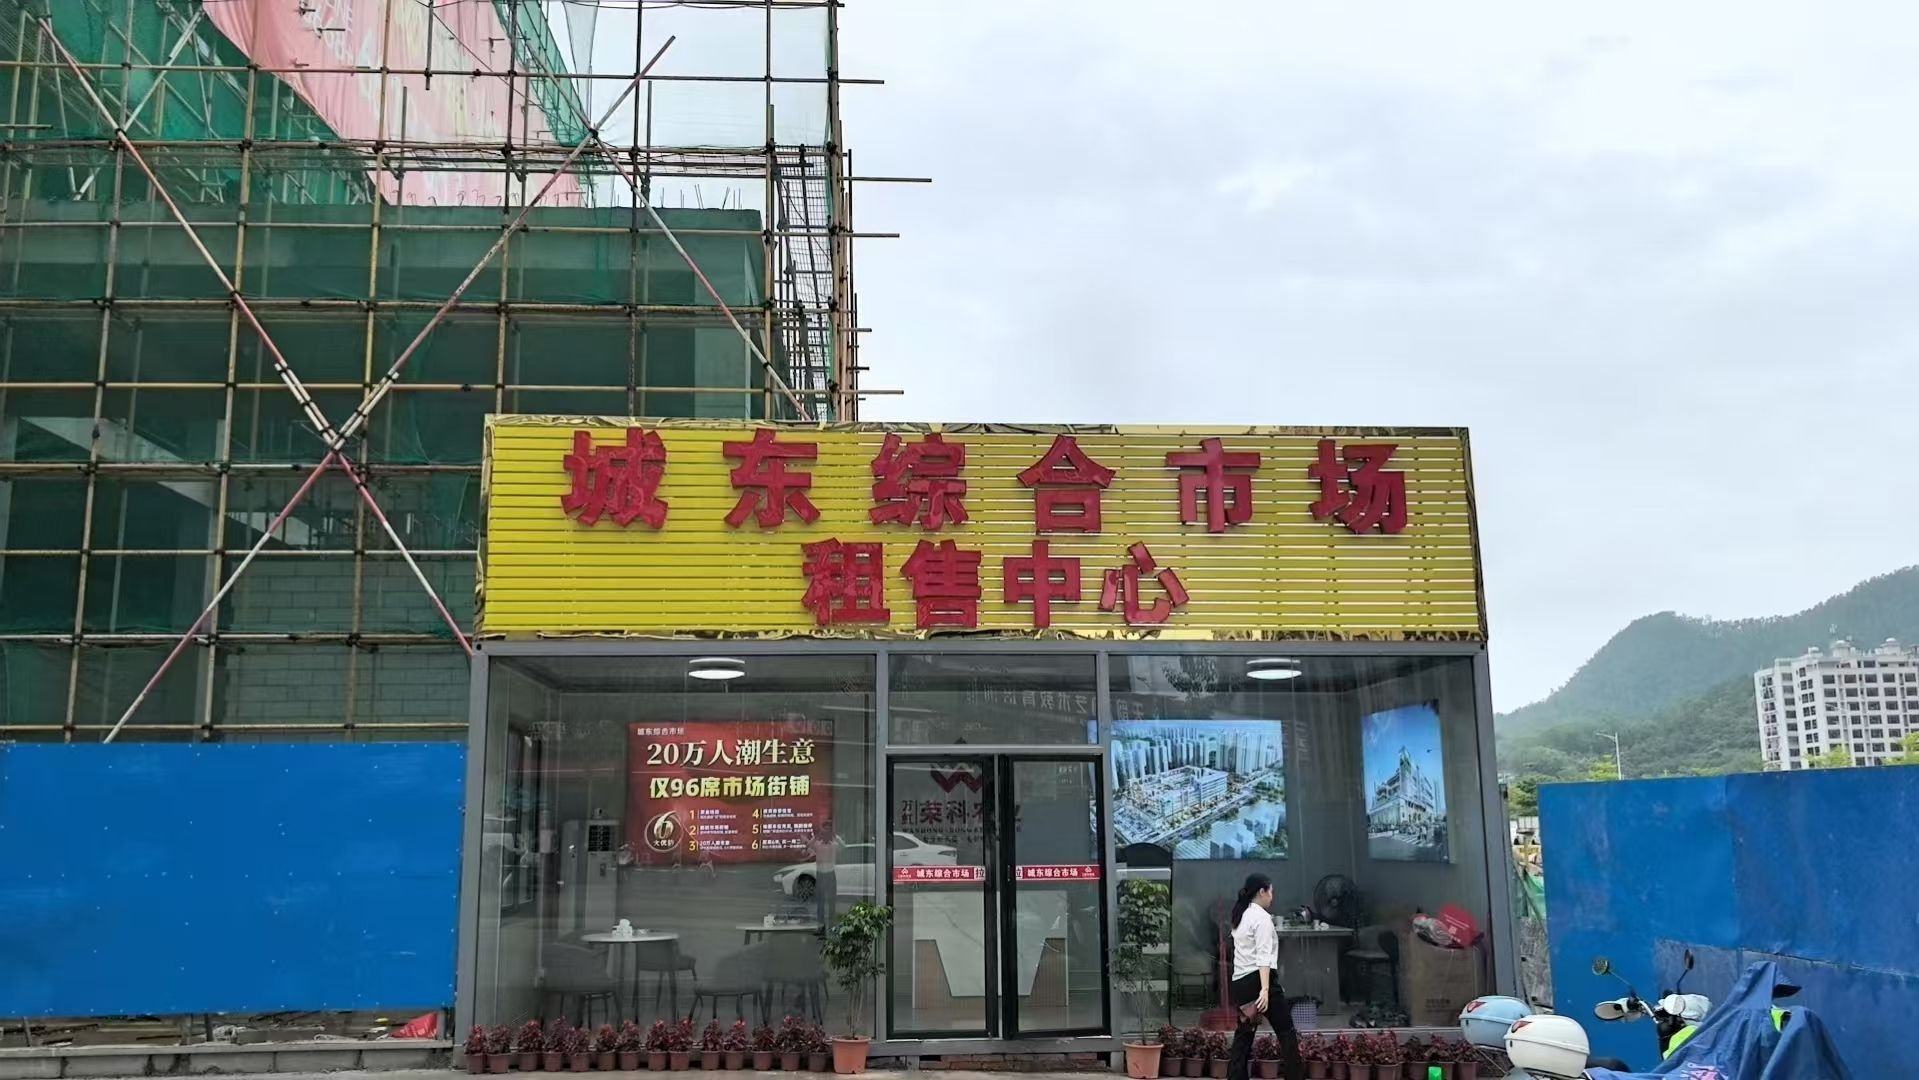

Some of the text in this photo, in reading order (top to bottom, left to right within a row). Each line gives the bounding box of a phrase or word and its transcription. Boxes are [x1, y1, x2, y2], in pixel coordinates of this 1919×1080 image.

[561, 427, 1408, 534] 城东综合市场
[801, 537, 1190, 629] 租售中心
[647, 738, 815, 766] 20万人潮生意
[649, 775, 811, 799] 仅96席市场街铺
[689, 810, 695, 820] 1
[752, 809, 759, 819] 4
[689, 826, 696, 836] 2
[752, 824, 759, 834] 5
[689, 841, 696, 851] 3
[752, 840, 759, 850] 6
[917, 868, 970, 879] 城东综合市场
[1027, 867, 1079, 878] 城东综合市场
